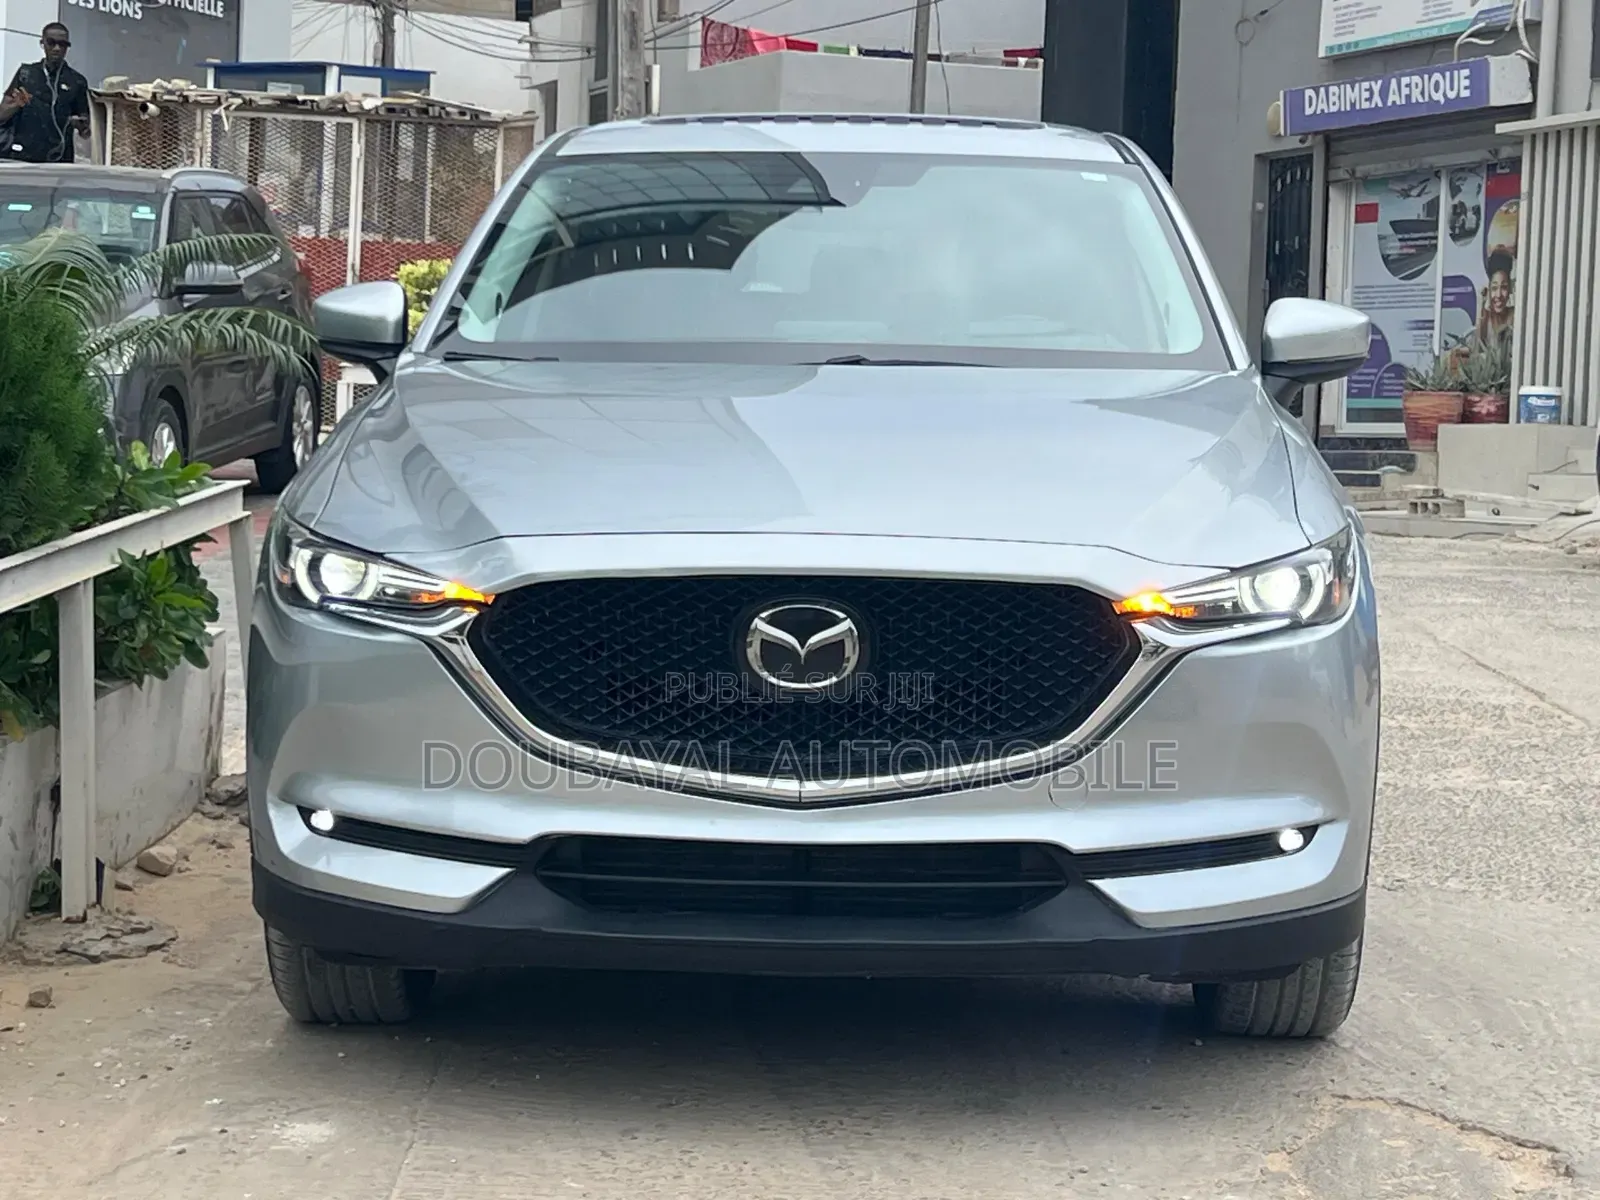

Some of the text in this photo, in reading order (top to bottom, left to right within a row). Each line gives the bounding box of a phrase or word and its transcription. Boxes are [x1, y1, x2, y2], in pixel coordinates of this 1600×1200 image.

[67, 0, 143, 20] ES LIONS
[158, 0, 224, 18] ICIELLE
[1304, 69, 1471, 116] DABIMEX AFRIQUE
